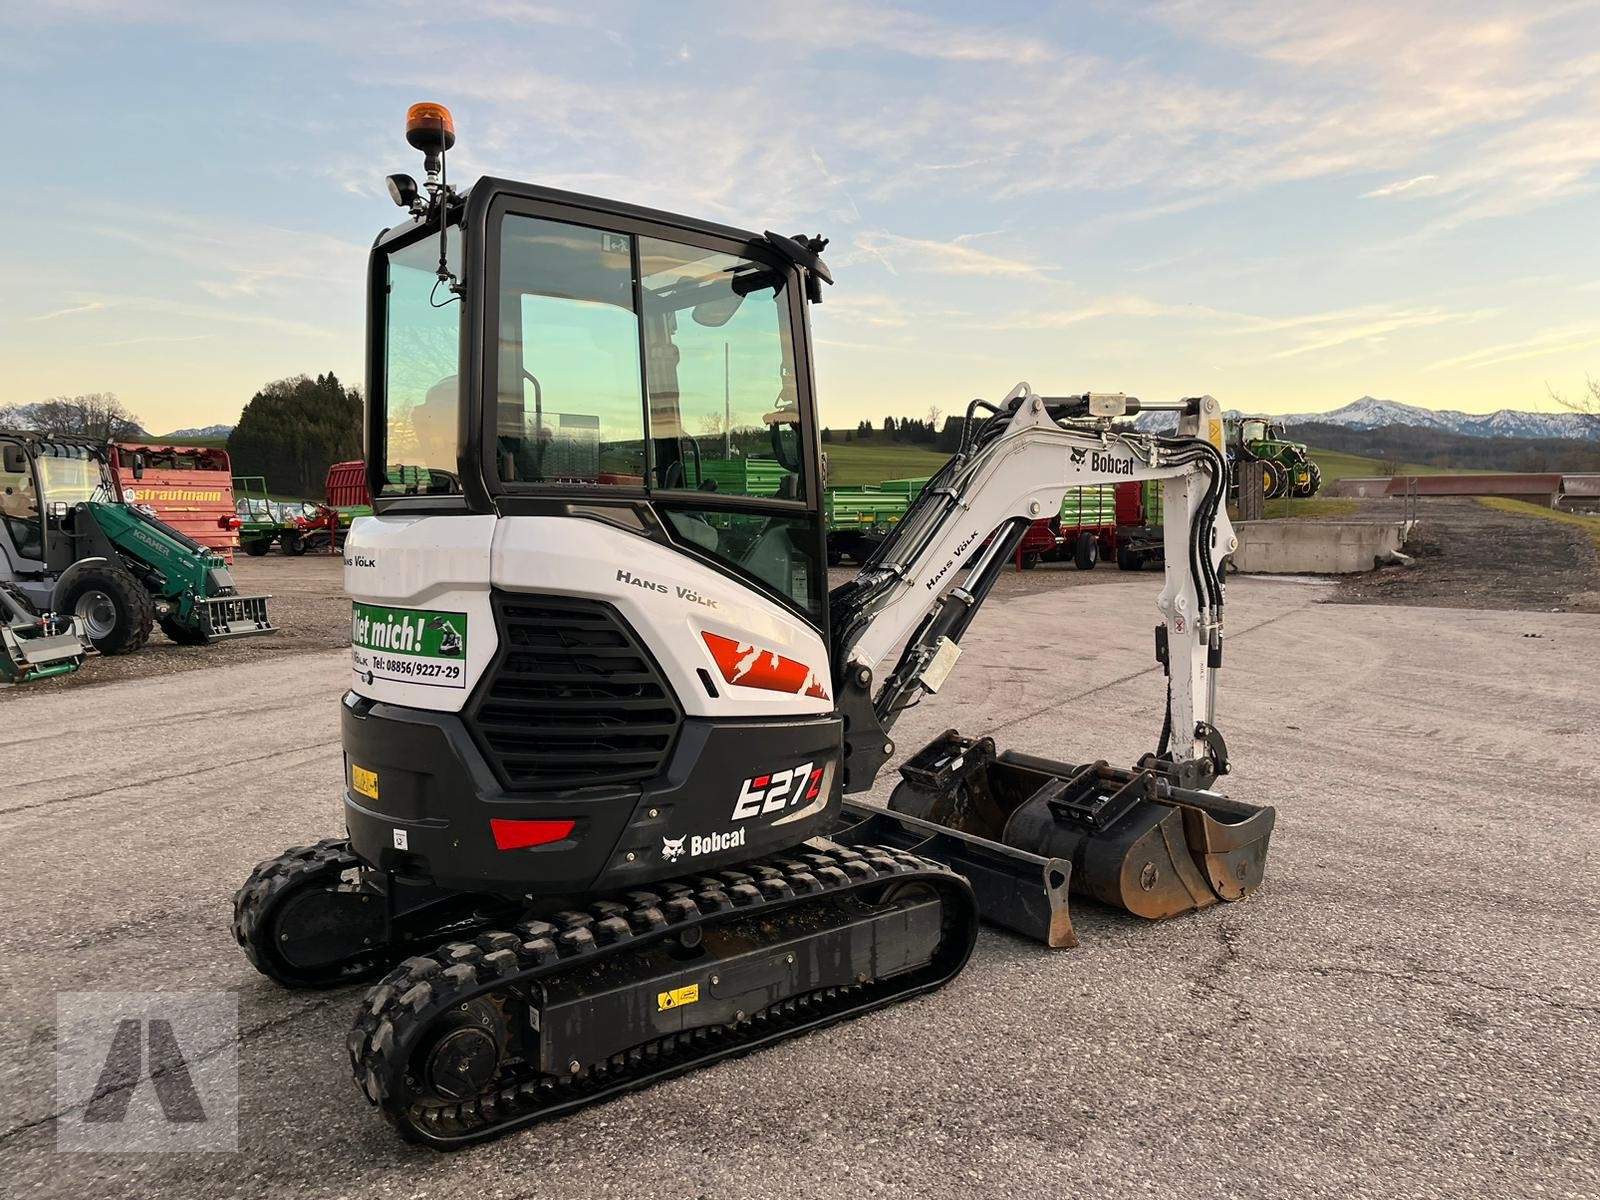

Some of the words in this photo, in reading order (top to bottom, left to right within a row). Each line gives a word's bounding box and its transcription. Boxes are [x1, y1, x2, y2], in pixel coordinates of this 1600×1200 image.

[1091, 452, 1134, 475] Bobcat
[135, 488, 221, 501] strautmann
[133, 529, 170, 556] KRAMER
[616, 569, 669, 594] HANS
[371, 613, 425, 652] mich!
[372, 656, 385, 670] Tel:
[386, 659, 460, 679] 08856/9227-29
[690, 826, 746, 857] Bobcat
